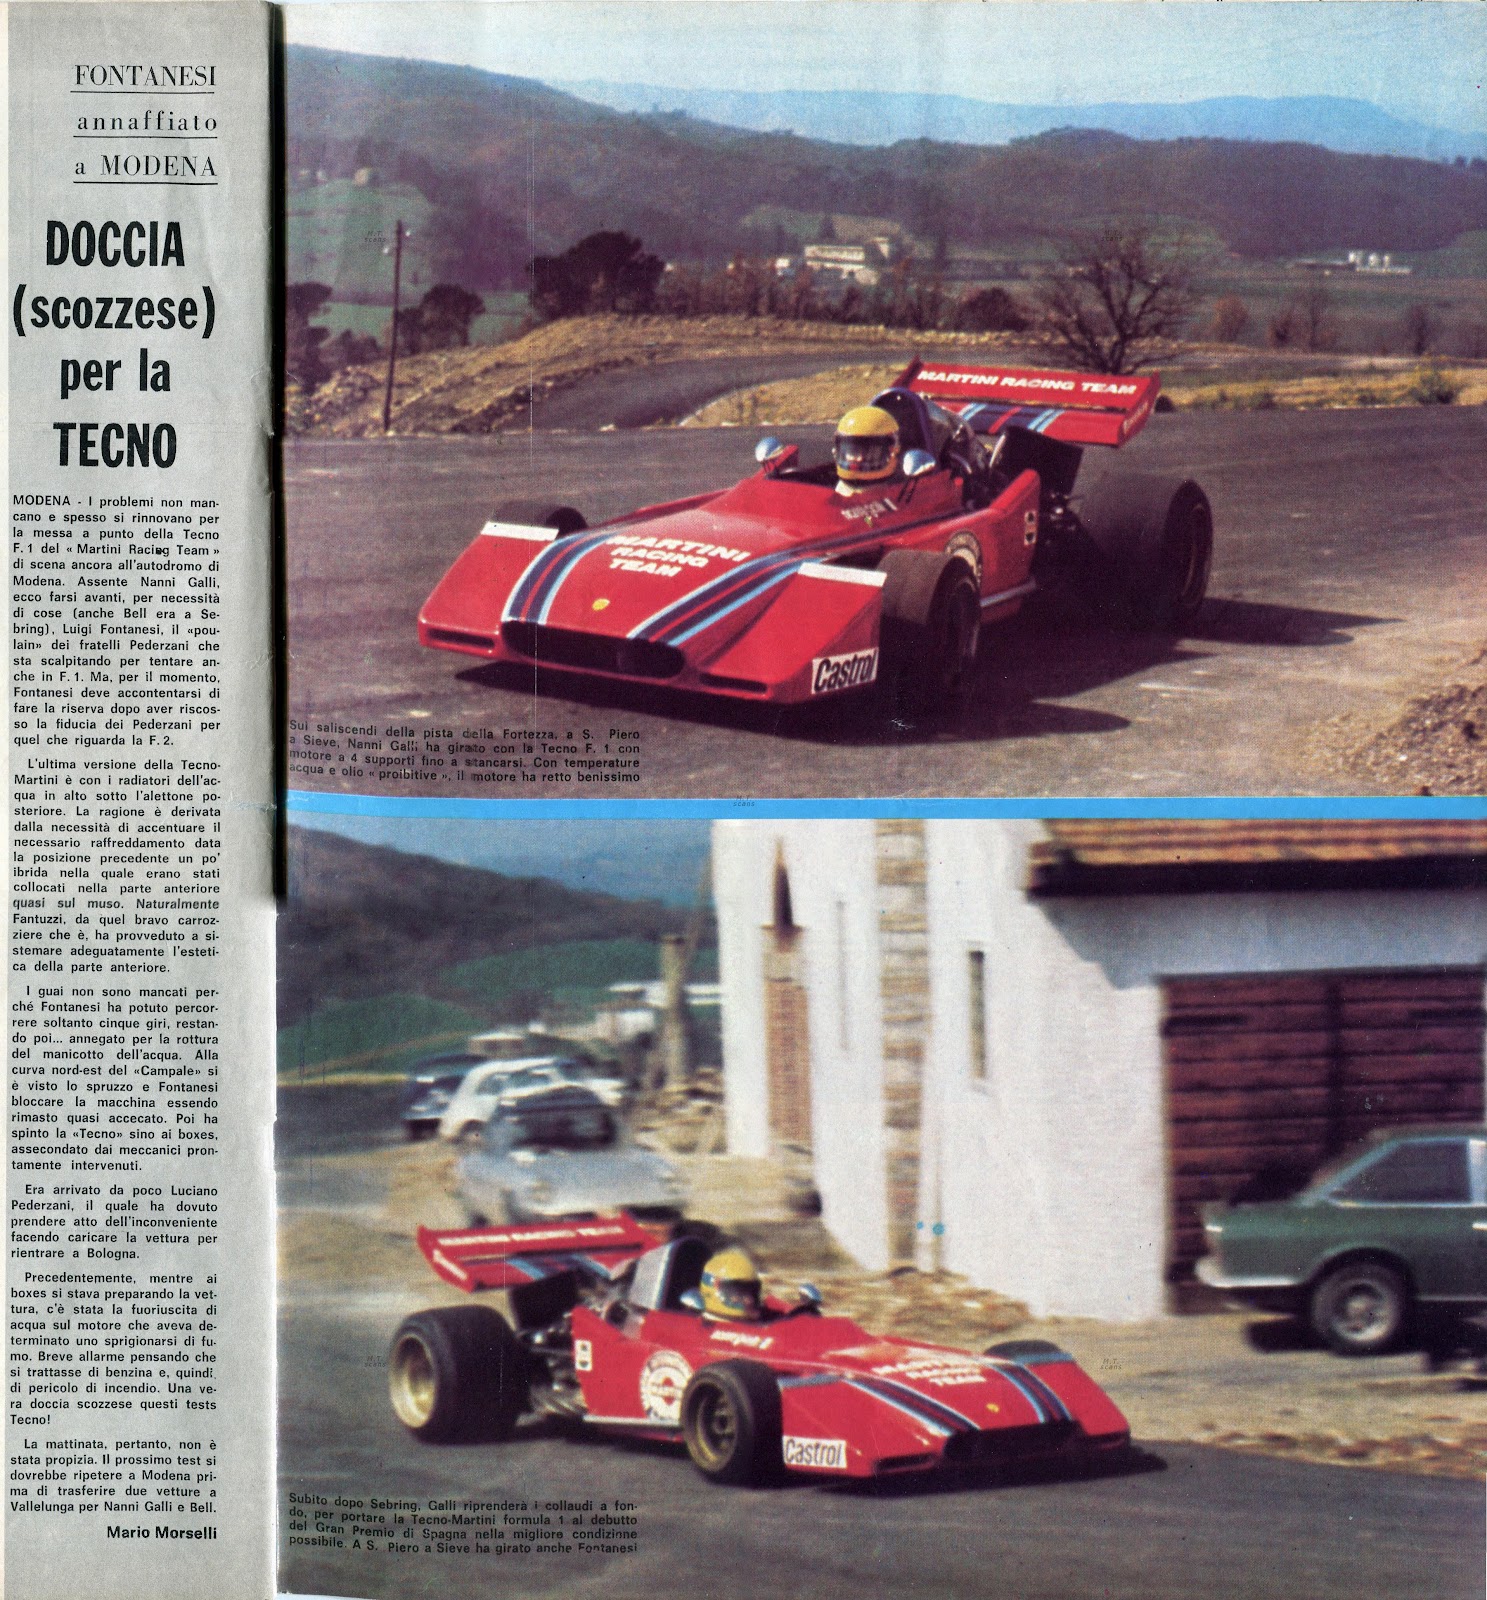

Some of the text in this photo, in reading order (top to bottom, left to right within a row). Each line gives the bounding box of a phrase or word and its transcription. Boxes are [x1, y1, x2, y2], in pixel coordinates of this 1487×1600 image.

[76, 65, 216, 87] FONTANESI
[77, 110, 218, 131] annaffiato
[75, 155, 218, 177] a MODENA
[46, 220, 186, 267] DOCCIA
[13, 284, 216, 338] (scozzese)
[61, 348, 171, 399] per la
[917, 370, 1137, 395] MARTINI RACING TEAM
[53, 422, 177, 468] TECNO
[14, 495, 71, 506] MODENA
[89, 496, 92, 506] I
[100, 496, 153, 509] problemi
[191, 500, 219, 508] man-
[606, 535, 751, 562] MARTINI
[610, 546, 709, 568] RACING
[609, 558, 682, 577] TEAM
[14, 576, 219, 588] Modena. Assente Nanni Galli,
[814, 649, 878, 692] Castrol
[14, 687, 220, 698] Fontanesi deve accontentarsi di
[290, 720, 308, 731] Sui
[317, 722, 377, 736] saliscendi
[386, 726, 415, 737] della
[423, 728, 454, 740] pista
[463, 728, 494, 739] della
[503, 728, 558, 740] Fortezza,
[583, 729, 594, 739] S.
[609, 729, 640, 739] Piero
[303, 735, 340, 748] Sieve,
[348, 738, 382, 750] Nanni
[426, 741, 440, 751] ha
[448, 743, 486, 754] girato
[494, 745, 515, 753] con
[523, 743, 533, 753] la
[541, 744, 577, 753] Tecno
[585, 744, 596, 753] F.
[618, 745, 640, 753] con
[28, 758, 220, 770] L'ultima versione della Tecno-
[290, 750, 332, 761] motore
[365, 755, 415, 767] supporti
[422, 755, 444, 766] fino
[465, 757, 526, 768] stancarsi.
[534, 757, 557, 768] Con
[565, 757, 640, 770] temperature
[290, 763, 324, 775] acqua
[342, 766, 363, 776] olio
[379, 769, 437, 780] proibitive
[457, 771, 464, 781] il
[472, 772, 516, 782] motore
[522, 771, 536, 782] ha
[542, 772, 572, 782] retto
[577, 771, 640, 782] benissimo
[15, 837, 221, 848] necessario raffreddamento data
[13, 898, 219, 910] quasi sul muso. Naturalmente
[12, 1096, 218, 1108] bloccare la macchina essendo
[26, 1184, 218, 1198] Era arrivato da poco Luciano
[26, 1272, 217, 1284] Precedentemente, mentre ai
[11, 1454, 216, 1467] stata propizia. Il prossimo test si
[785, 1438, 842, 1466] Castrol
[290, 1493, 328, 1505] Subito
[334, 1496, 364, 1509] dopo
[370, 1499, 421, 1512] Sebring,
[428, 1500, 456, 1511] Galli
[464, 1500, 527, 1513] riprenderà
[545, 1500, 593, 1511] collaudi
[614, 1500, 638, 1511] fon-
[290, 1507, 307, 1518] do,
[314, 1510, 334, 1520] per
[341, 1512, 385, 1523] portare
[394, 1513, 404, 1524] la
[411, 1514, 496, 1525] Tecno-Martini
[504, 1514, 550, 1525] formula
[572, 1514, 583, 1525] al
[591, 1514, 638, 1525] debutto
[108, 1526, 217, 1540] Mario Morselli
[290, 1521, 307, 1531] del
[316, 1522, 344, 1534] Gran
[352, 1525, 395, 1538] Premio
[403, 1528, 414, 1538] di
[422, 1528, 467, 1541] Spagna
[475, 1528, 504, 1539] nella
[513, 1528, 564, 1542] migliore
[290, 1536, 347, 1548] possibile.
[367, 1540, 378, 1550] S.
[388, 1542, 419, 1553] Piero
[437, 1543, 470, 1553] Sieve
[476, 1543, 490, 1553] ha
[495, 1543, 531, 1555] girato
[536, 1543, 572, 1553] anche
